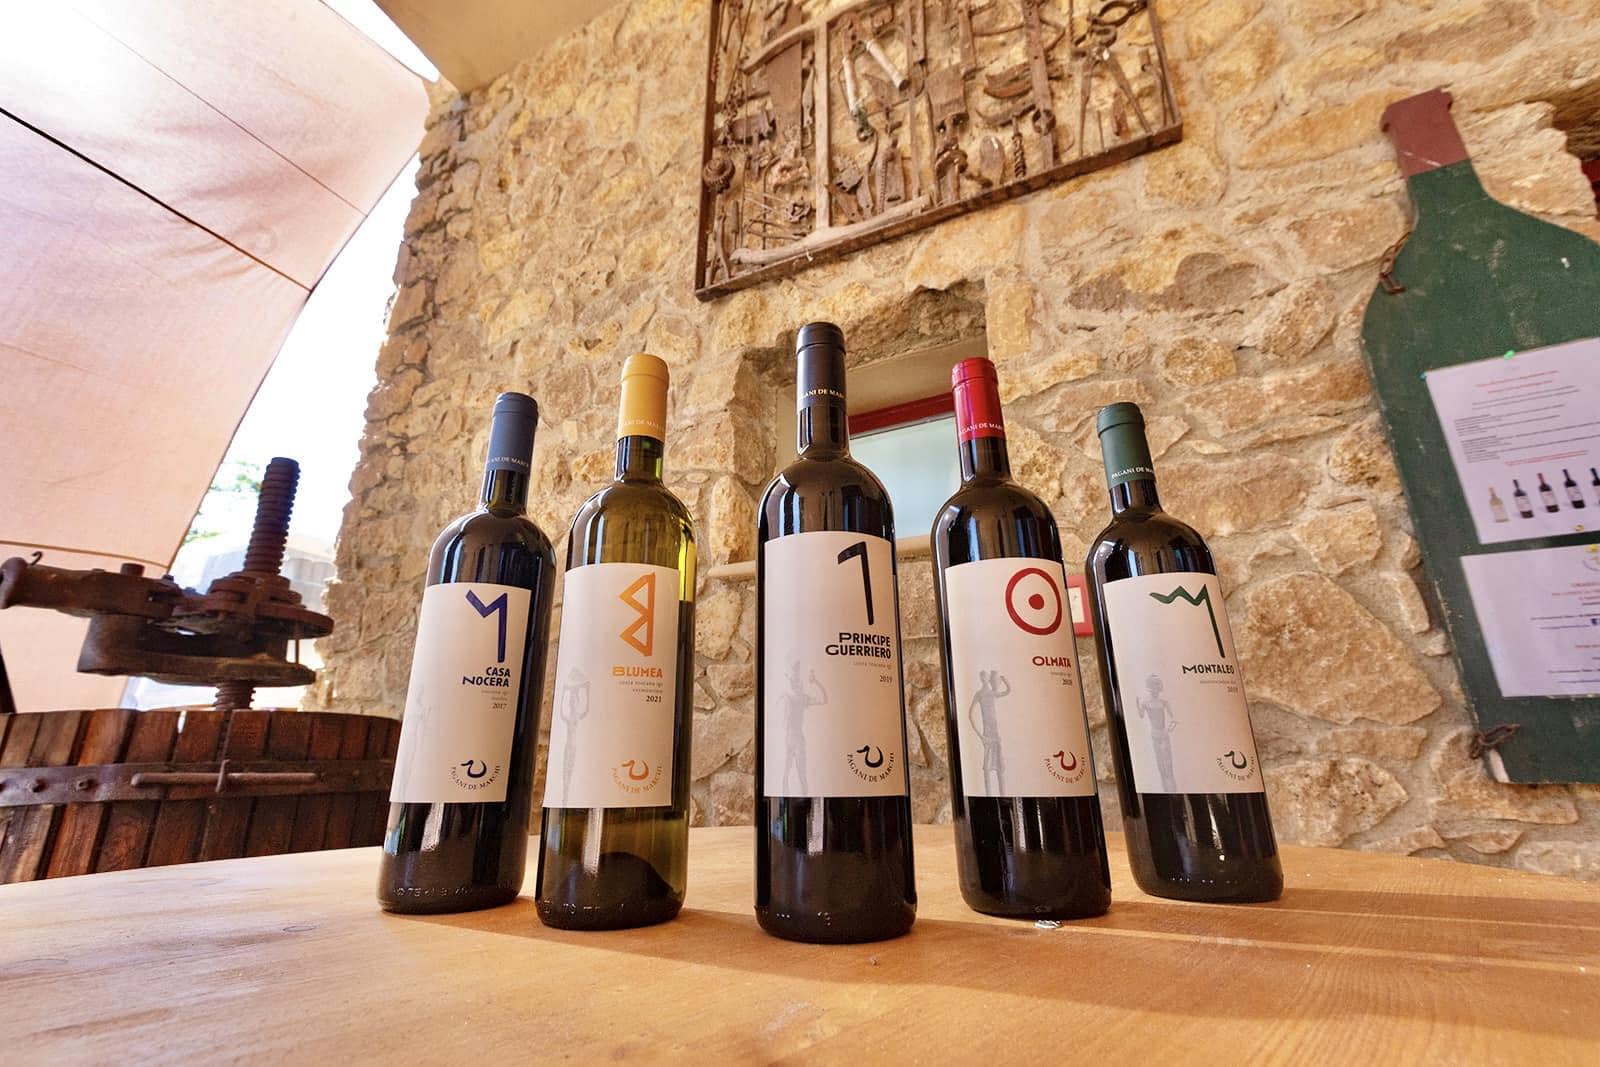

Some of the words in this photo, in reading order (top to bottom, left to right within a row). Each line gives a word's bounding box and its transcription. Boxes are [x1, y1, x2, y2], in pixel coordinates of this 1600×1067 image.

[839, 632, 891, 647] PRINCIPE
[825, 644, 891, 659] GUERRIERO
[1032, 655, 1072, 668] OLMATA
[486, 666, 511, 678] CASA
[612, 666, 664, 679] BLUMEA
[1182, 664, 1235, 675] MONTALEO
[462, 676, 509, 688] NOCERA
[645, 695, 662, 703] 2021
